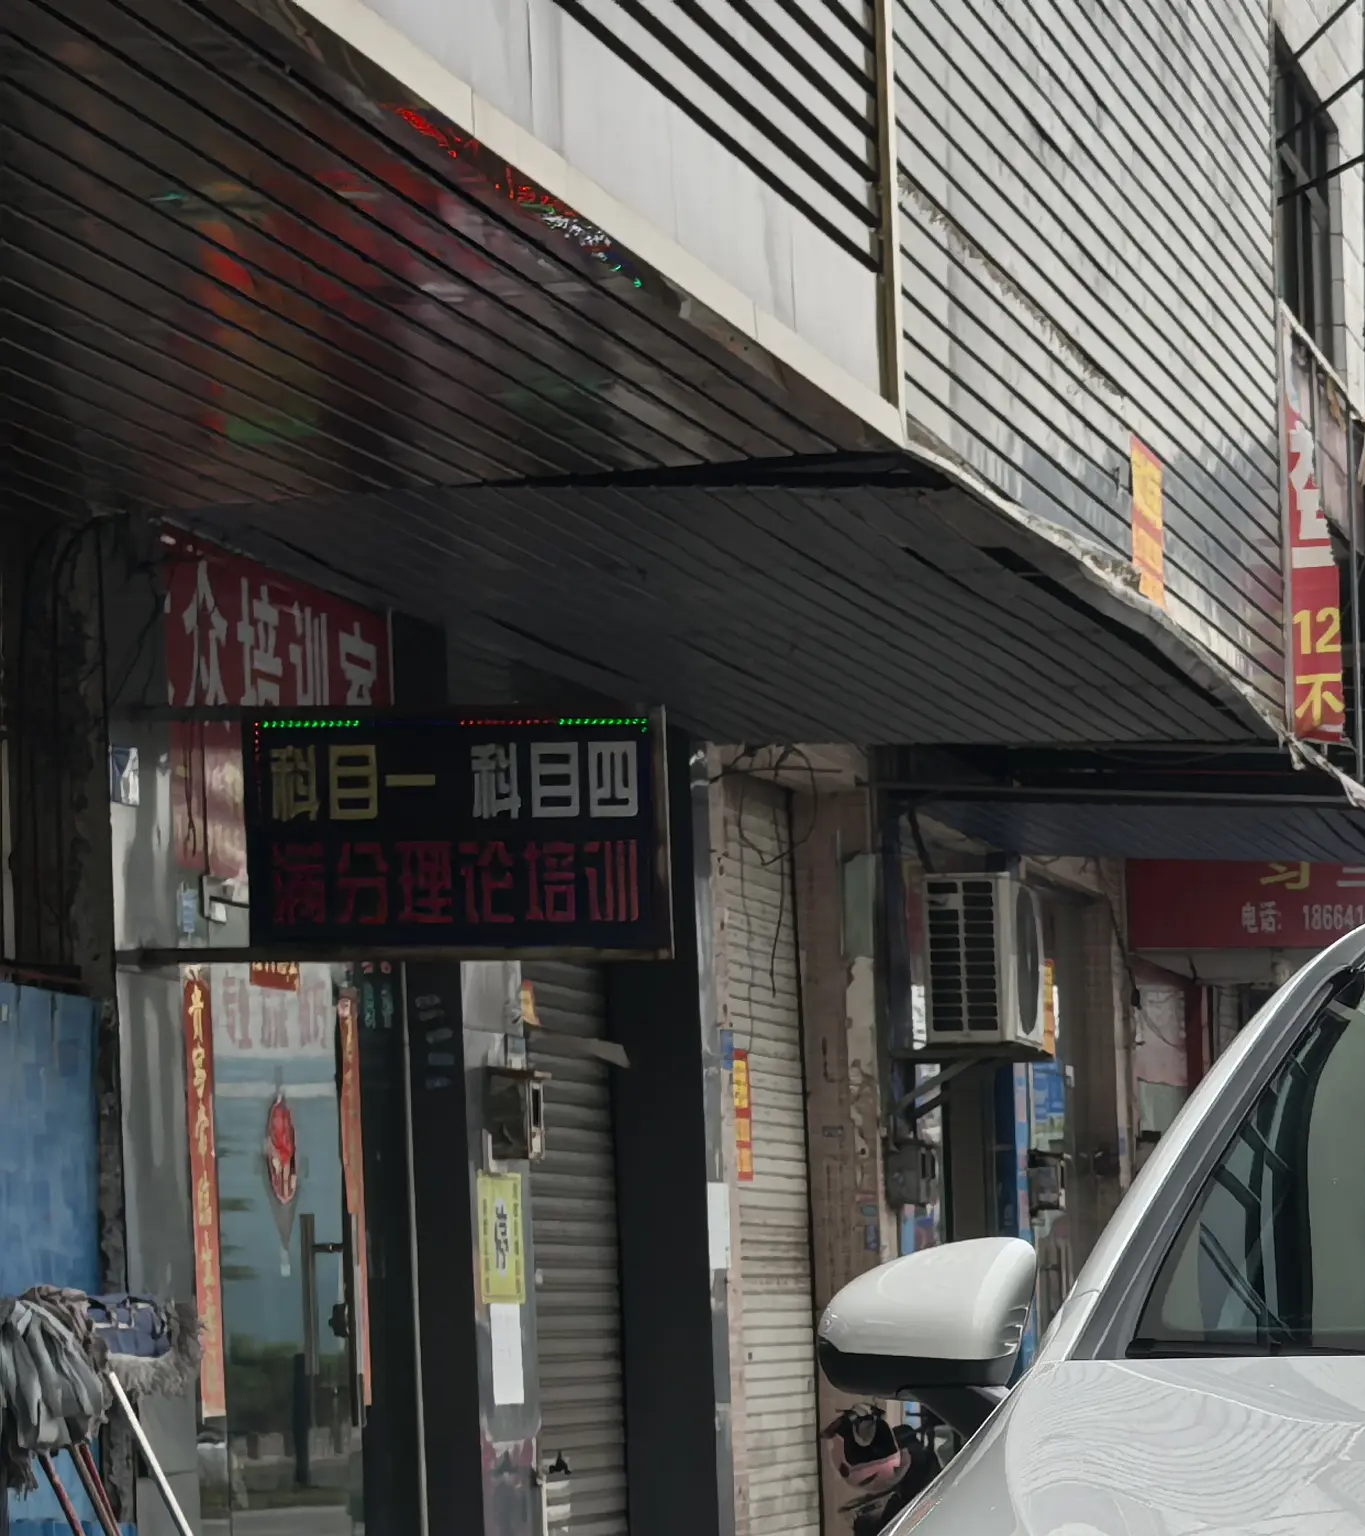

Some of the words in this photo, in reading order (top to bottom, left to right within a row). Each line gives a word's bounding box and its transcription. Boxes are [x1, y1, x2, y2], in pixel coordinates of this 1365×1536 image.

[269, 742, 437, 822] 科目一
[470, 740, 639, 819] 科目四
[271, 838, 640, 925] 满分理论培训
